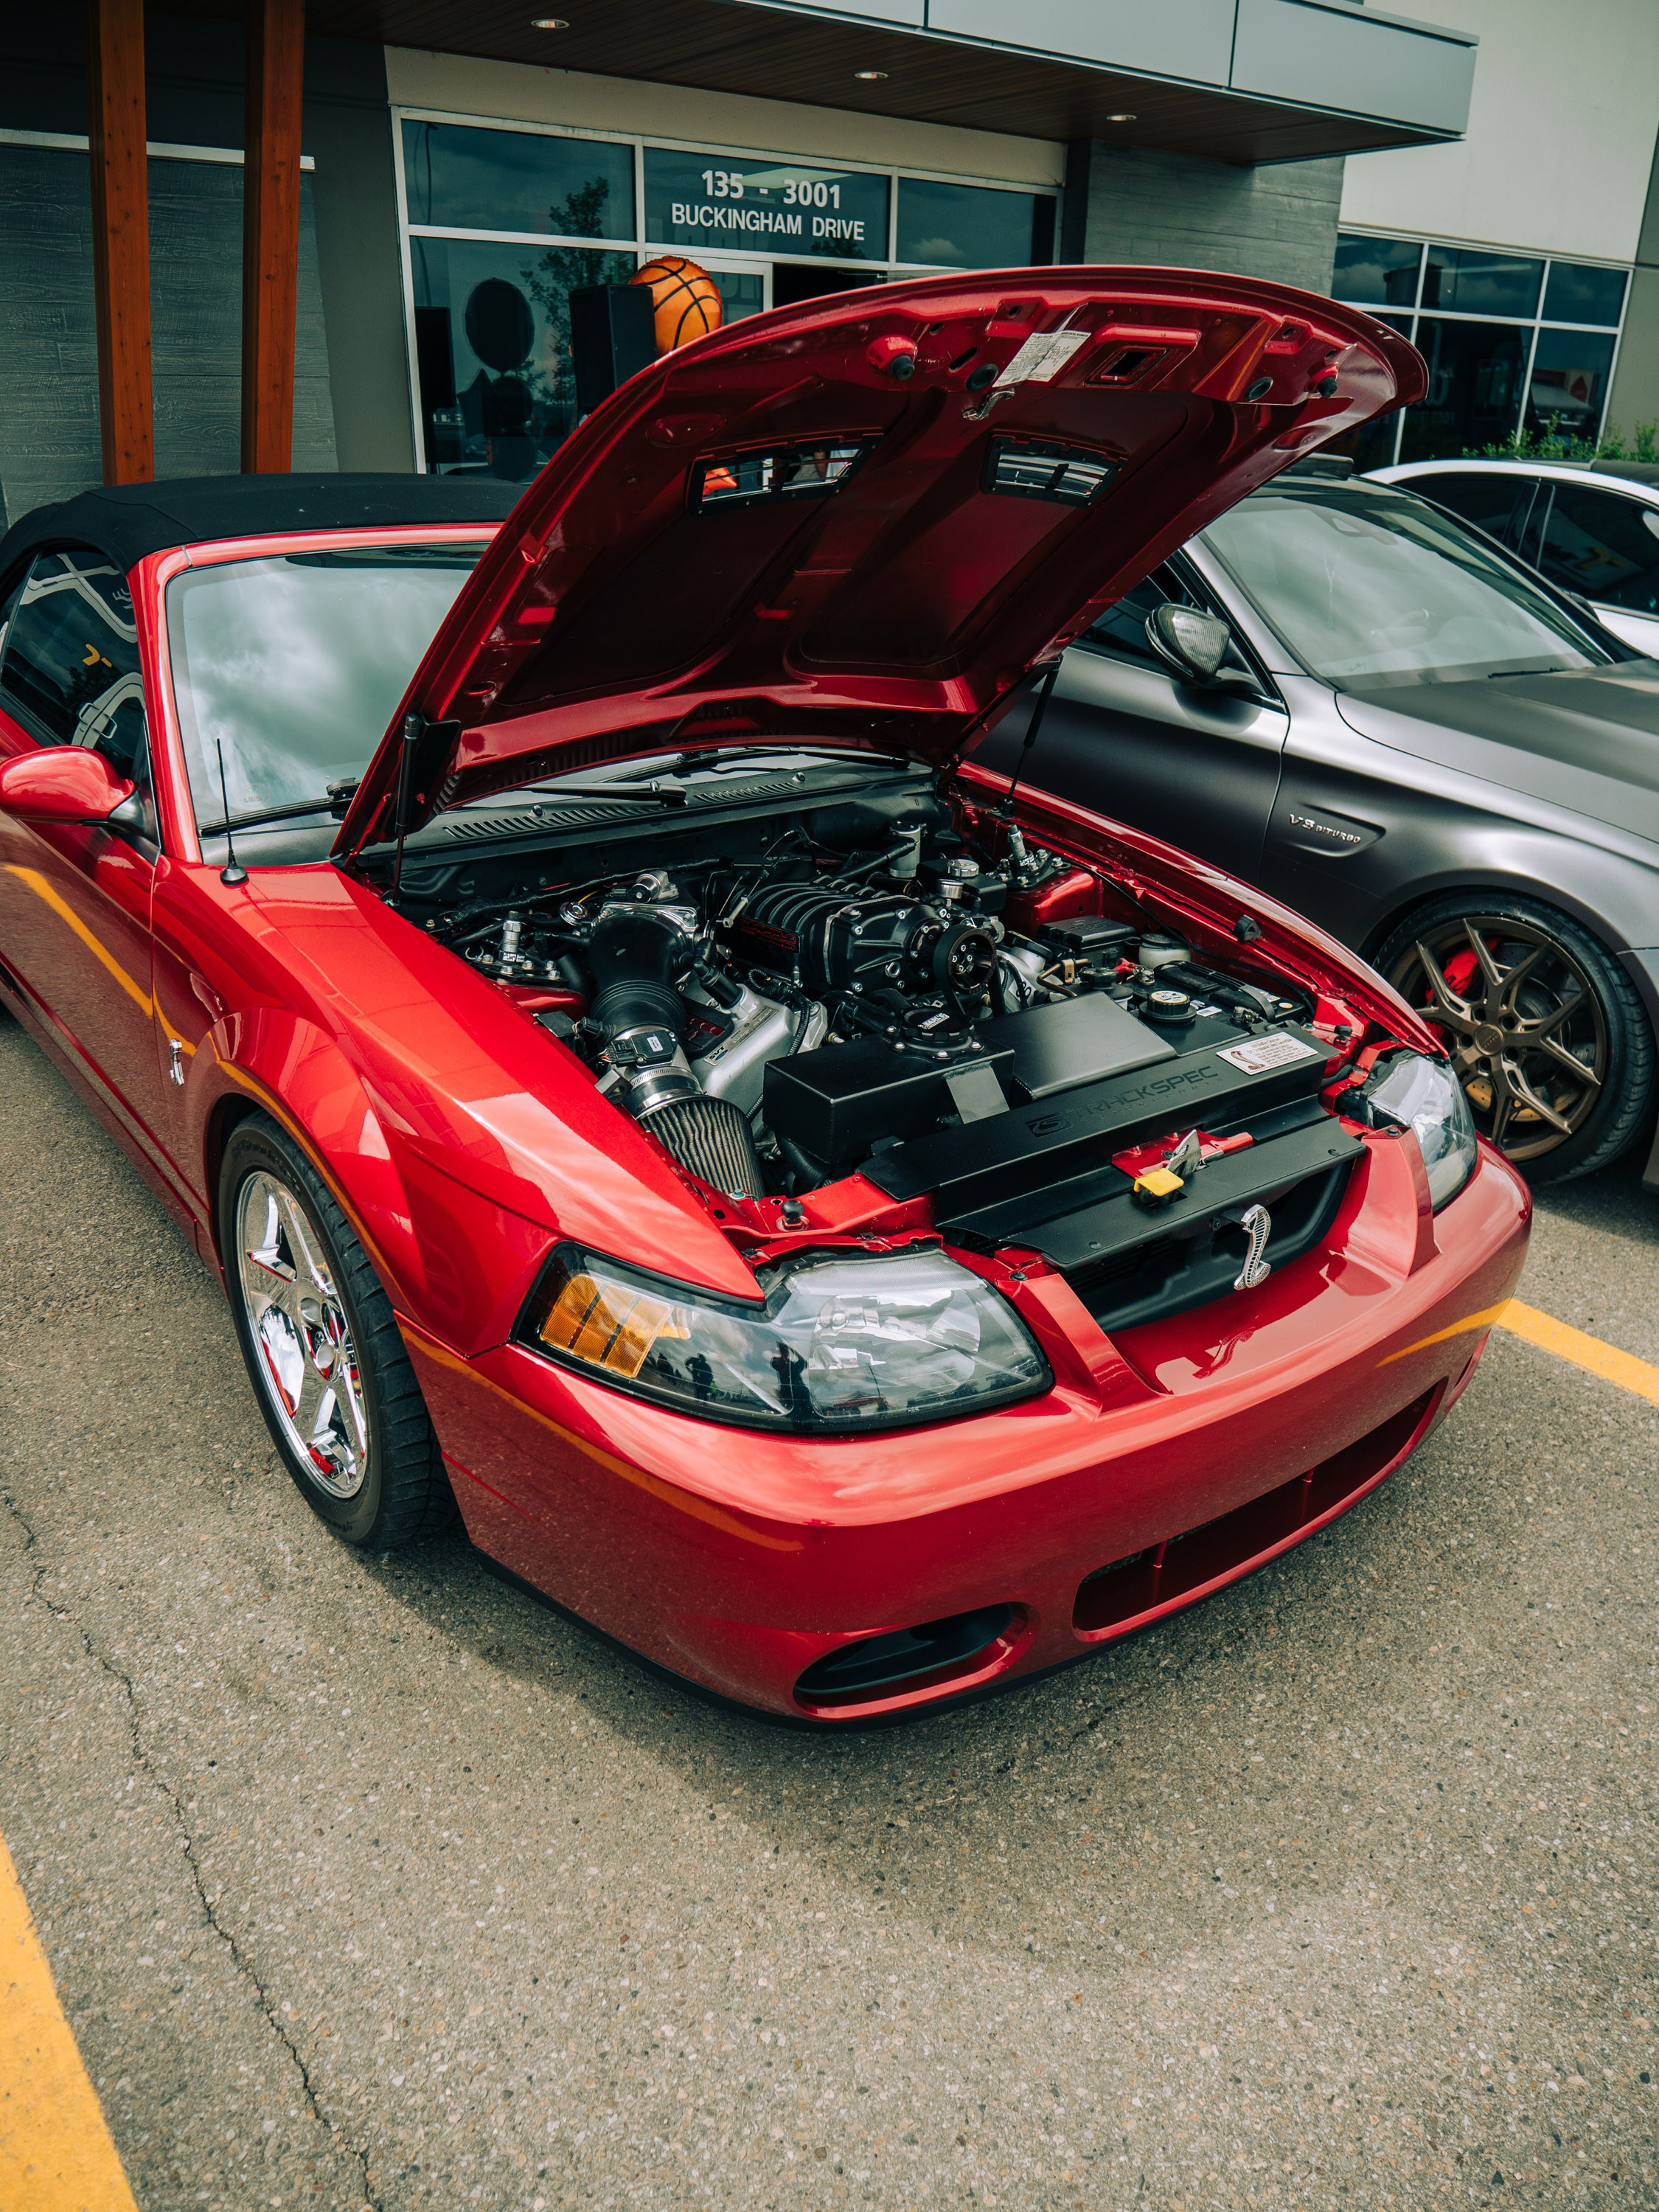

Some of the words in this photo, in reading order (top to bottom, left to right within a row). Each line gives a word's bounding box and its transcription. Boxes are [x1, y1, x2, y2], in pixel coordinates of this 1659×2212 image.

[701, 170, 745, 199] 135
[783, 178, 840, 209] 3001
[672, 203, 802, 235] BUCKINGHAM
[812, 217, 865, 241] DRIVE
[1290, 813, 1315, 830] V8
[1315, 824, 1361, 844] BITURBO
[1067, 1066, 1218, 1119] TRACKSPEC
